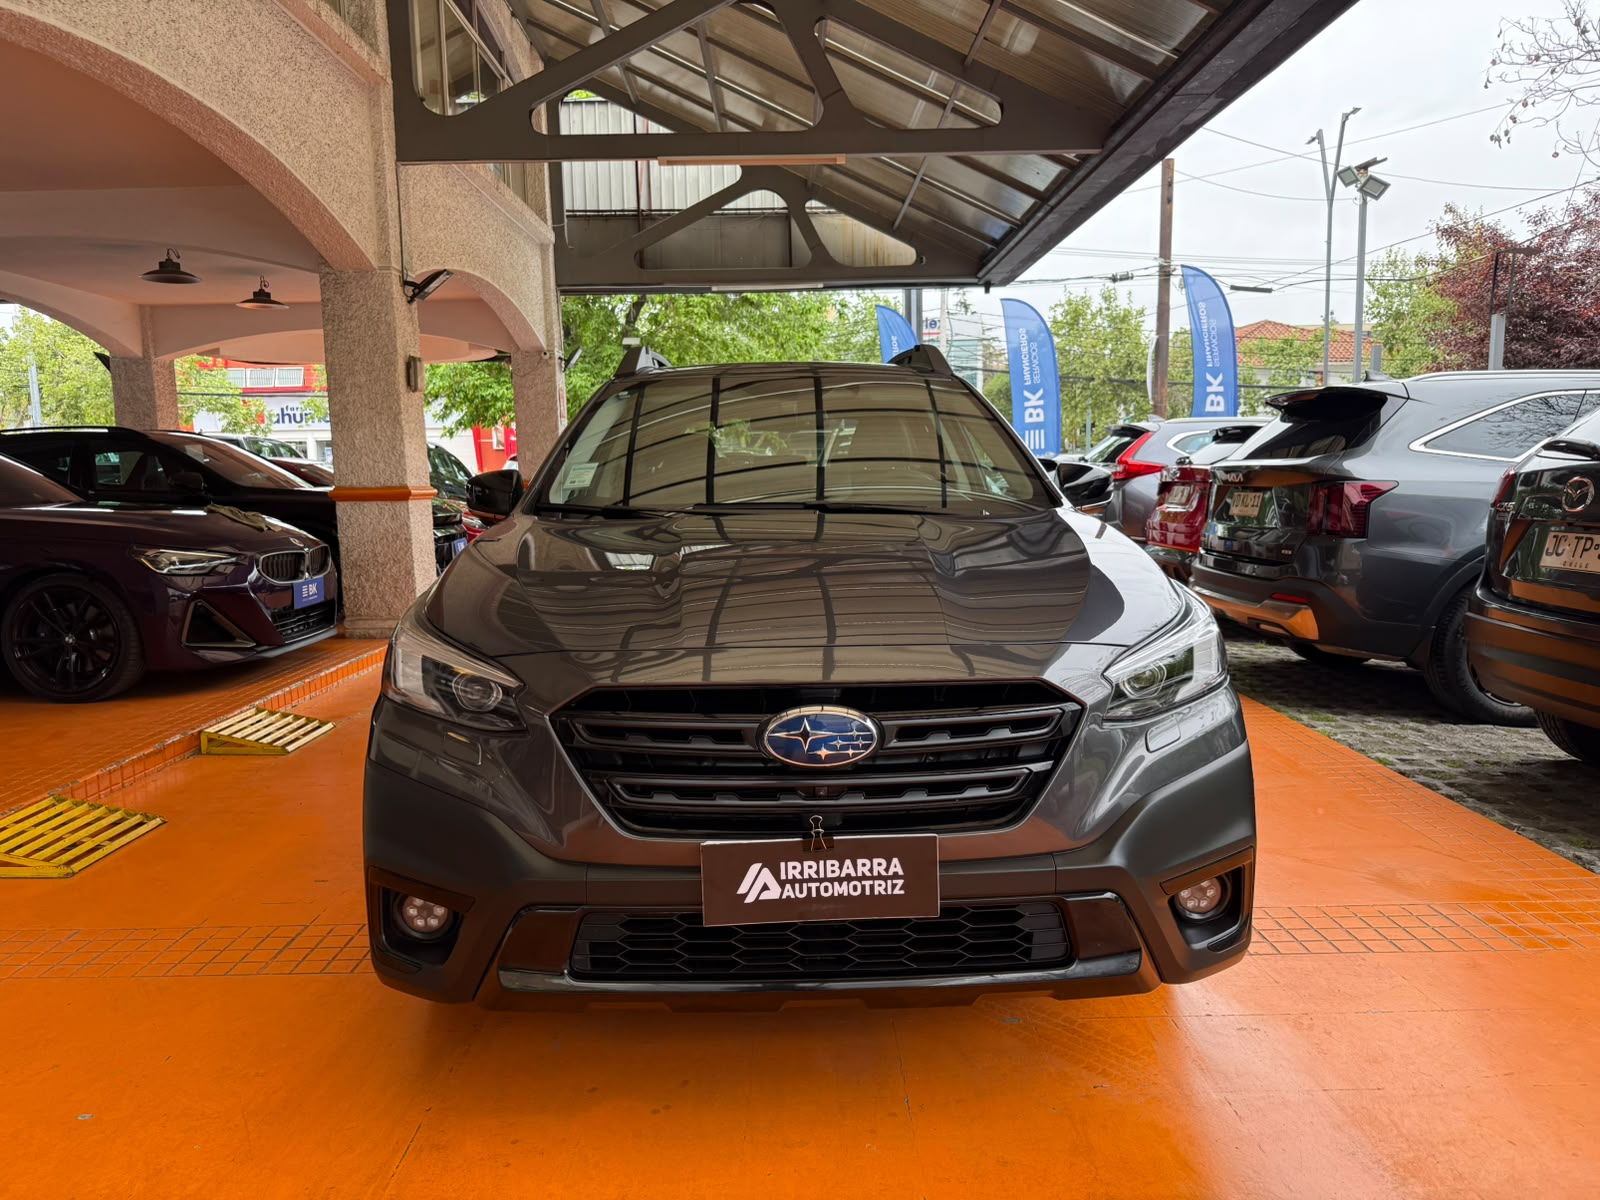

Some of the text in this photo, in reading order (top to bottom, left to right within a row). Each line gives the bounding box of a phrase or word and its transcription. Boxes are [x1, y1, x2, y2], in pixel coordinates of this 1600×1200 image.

[308, 582, 318, 595] BK
[780, 857, 904, 880] IRRIBARRA
[781, 879, 905, 899] AUTOMOTRIZ
